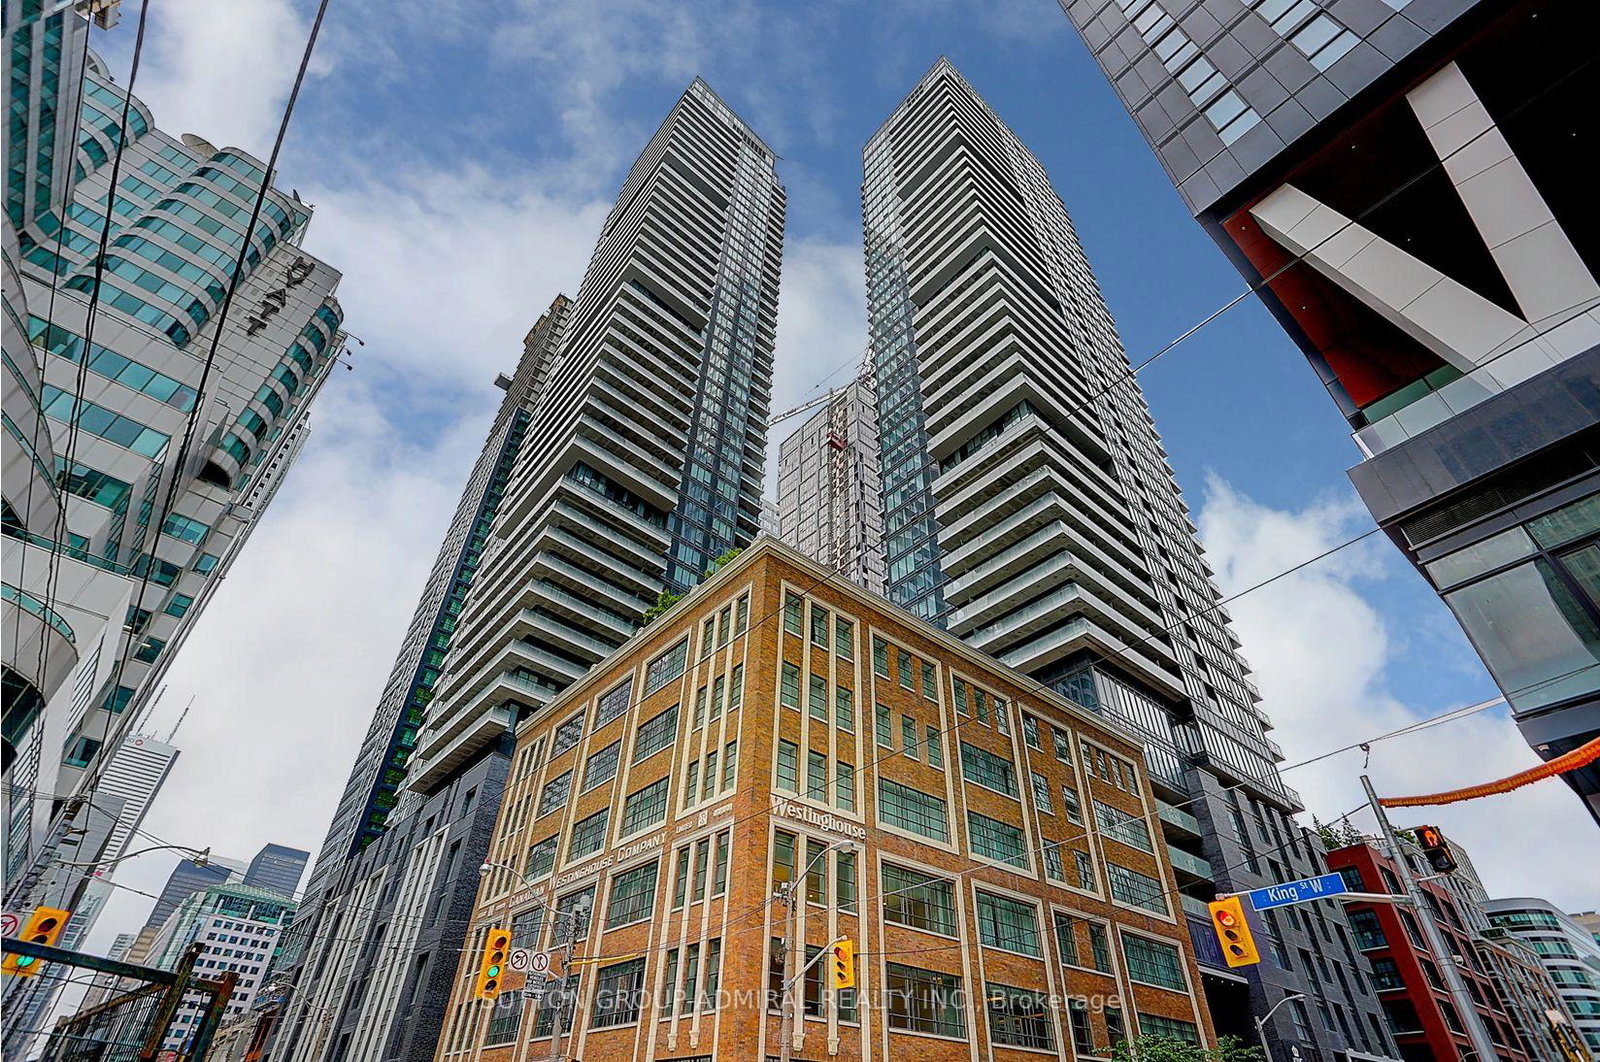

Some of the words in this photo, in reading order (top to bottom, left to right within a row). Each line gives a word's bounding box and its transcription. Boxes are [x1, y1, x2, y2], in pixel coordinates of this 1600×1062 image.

[247, 256, 316, 336] HYATT
[771, 794, 867, 840] Westinghouse
[617, 831, 668, 862] COMPANY
[1268, 886, 1299, 902] King
[1300, 881, 1309, 890] St
[1309, 878, 1323, 893] W
